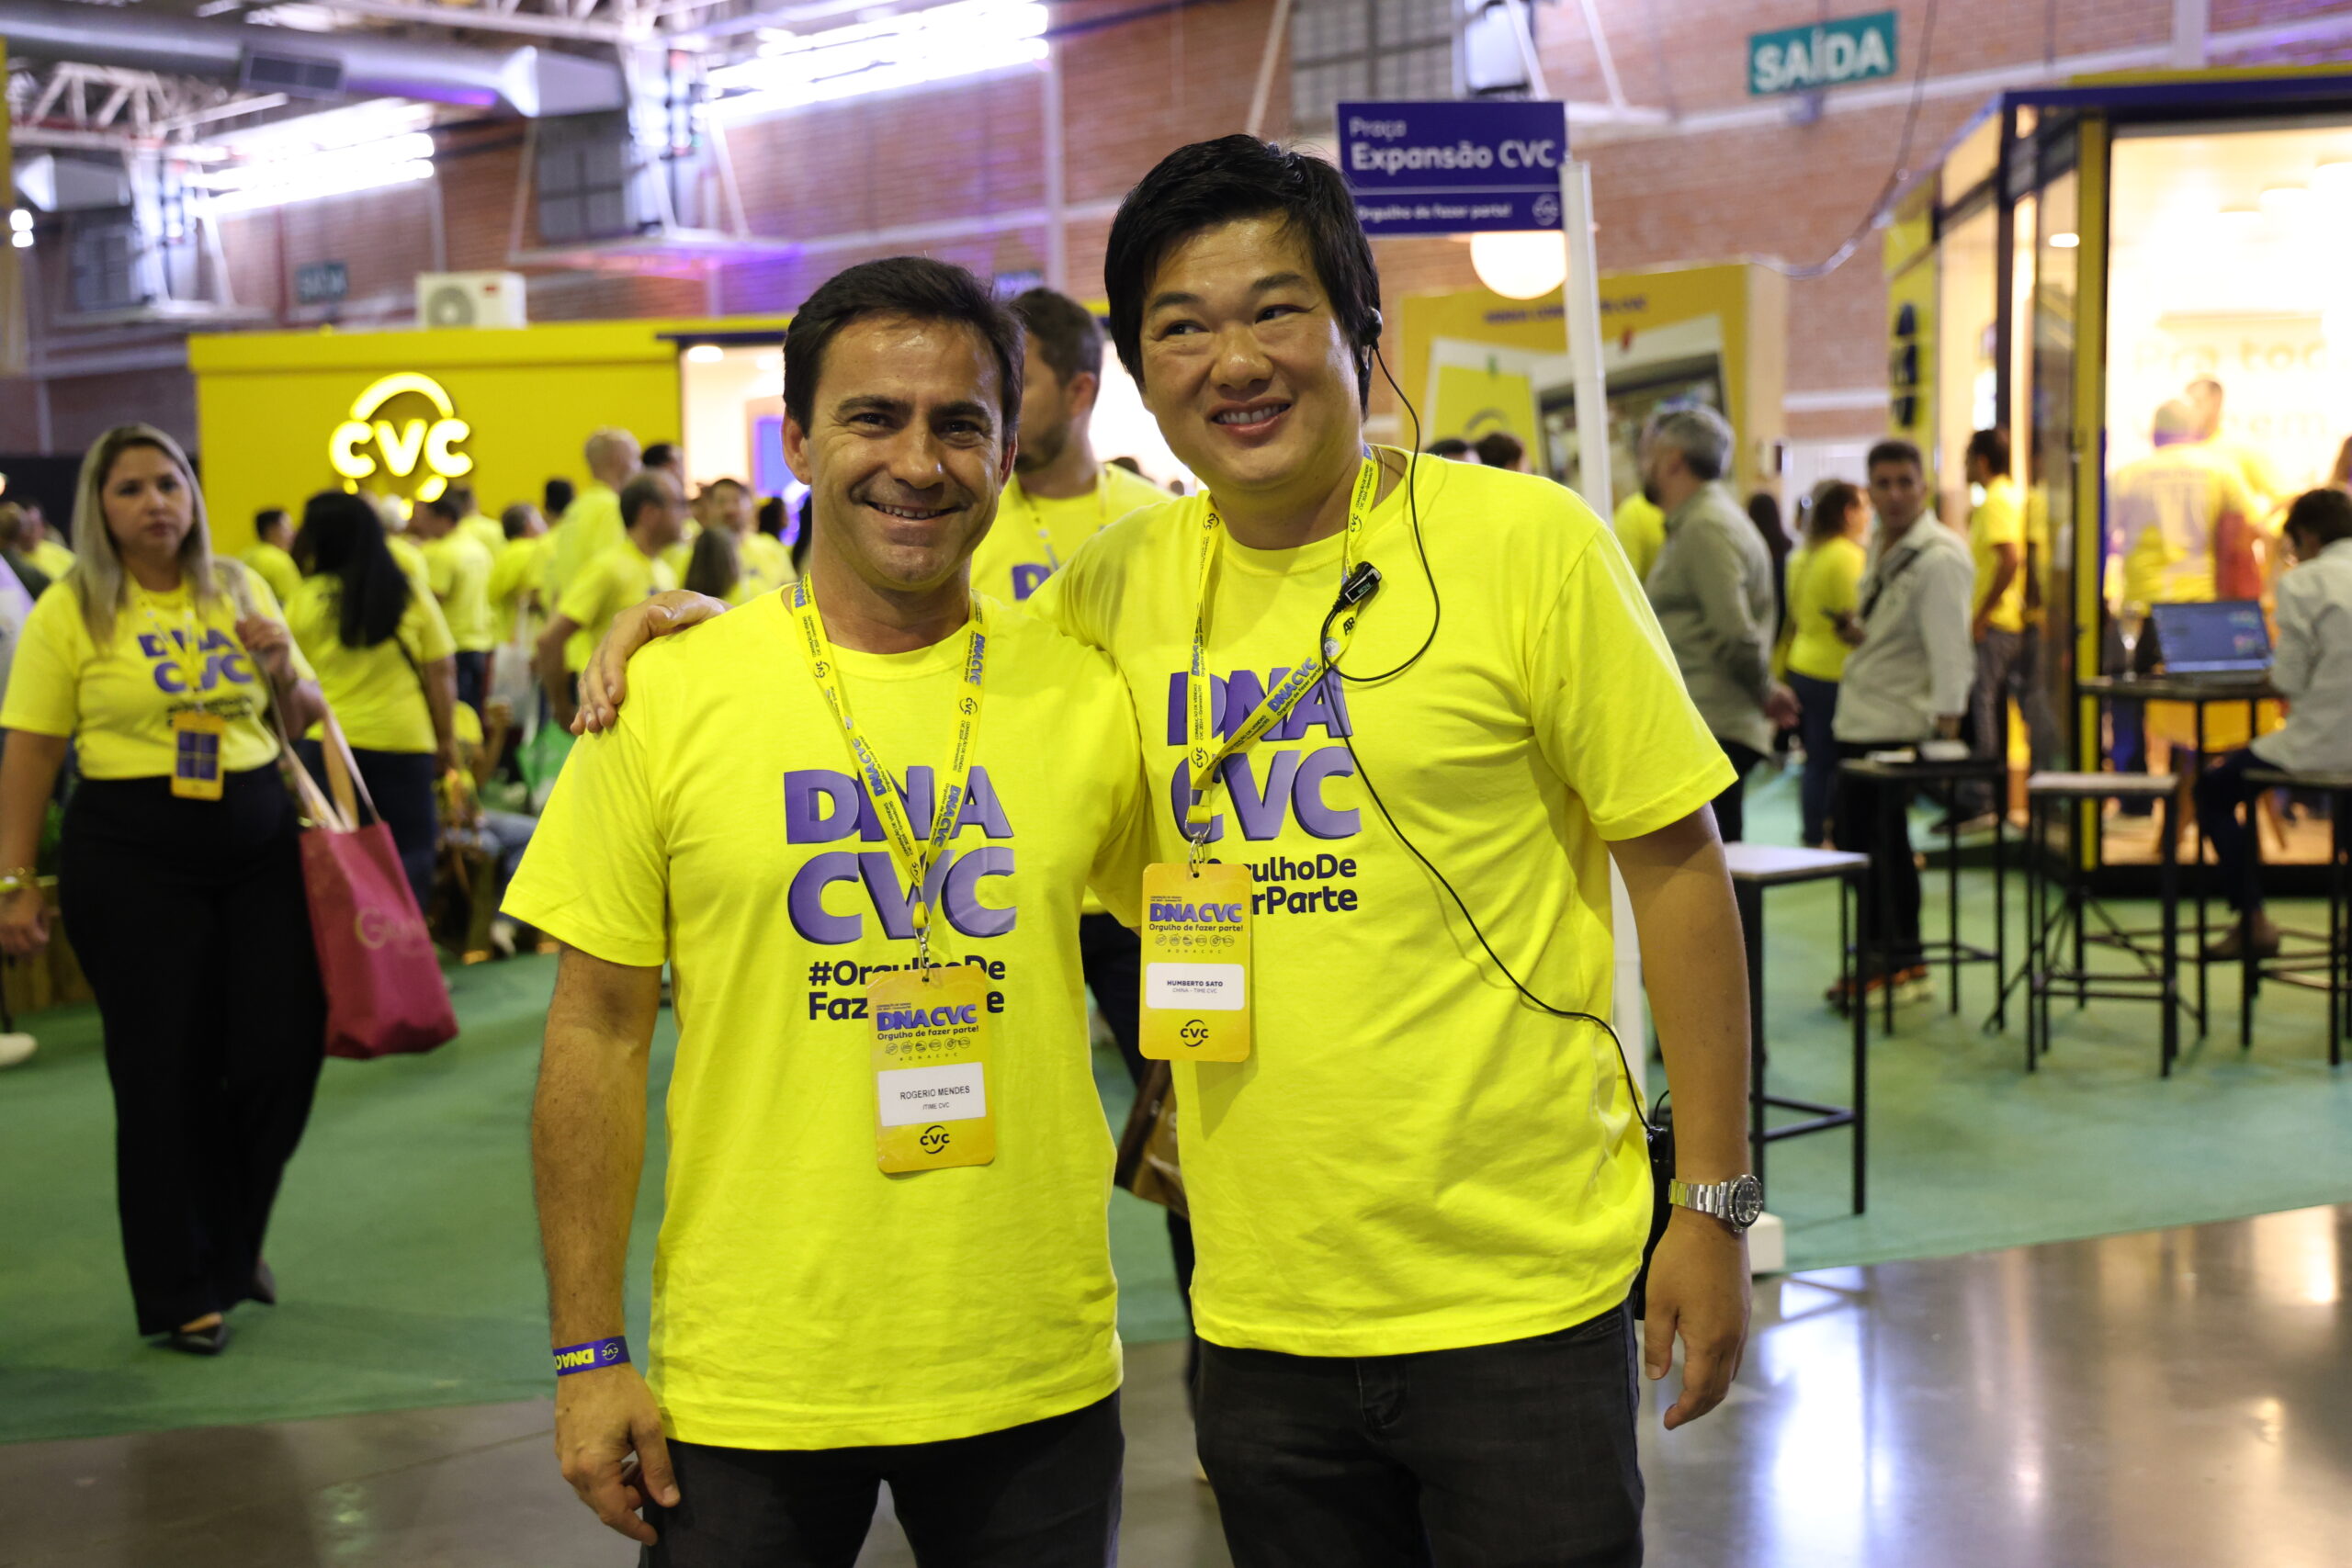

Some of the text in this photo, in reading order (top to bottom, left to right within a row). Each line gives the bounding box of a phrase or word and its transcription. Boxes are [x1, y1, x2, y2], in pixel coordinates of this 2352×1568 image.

[1753, 26, 1890, 92] SAÍDA
[1349, 116, 1408, 142] Praça
[1351, 139, 1556, 175] Expansão CVC
[328, 418, 474, 479] CVC
[964, 697, 973, 716] CVC
[1168, 668, 1353, 746] DNA
[784, 765, 1014, 844] DNA
[1171, 747, 1363, 843] CVC
[787, 846, 1017, 945] CVC
[1149, 923, 1182, 932] Orgulho
[877, 1032, 913, 1041] Orgulho
[953, 1026, 979, 1035] parte!
[1181, 1028, 1209, 1039] CVC
[900, 1085, 970, 1100] ROGERIO MENDES
[920, 1134, 951, 1145] CVC
